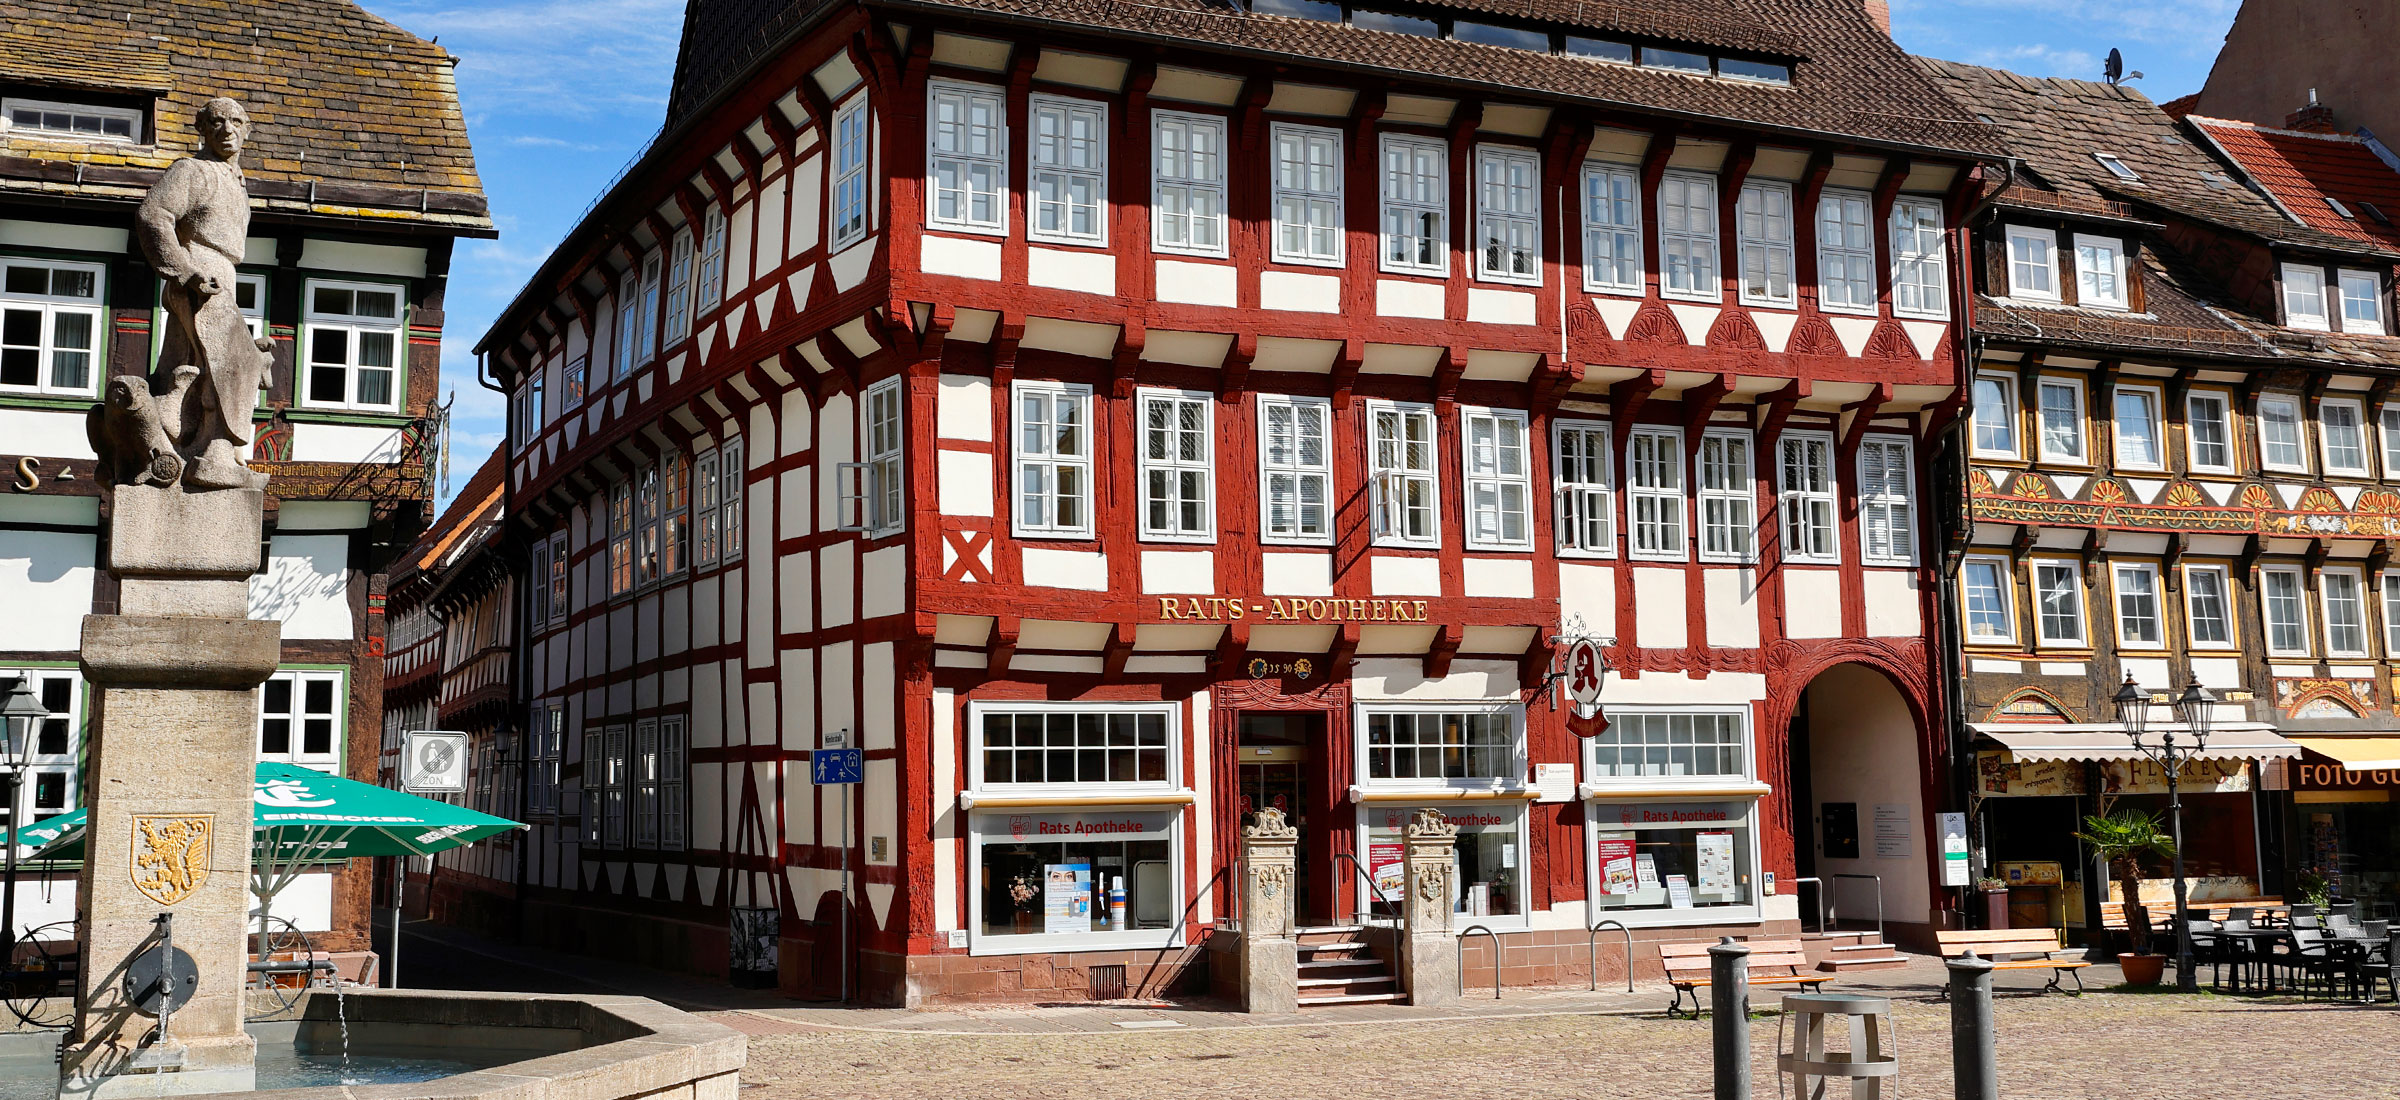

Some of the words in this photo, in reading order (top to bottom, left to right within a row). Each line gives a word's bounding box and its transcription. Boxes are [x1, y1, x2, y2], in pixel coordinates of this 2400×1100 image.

[422, 776, 445, 785] ZON
[2129, 758, 2228, 786] FLRES
[2299, 763, 2362, 786] FOTO
[1643, 810, 1669, 823] Rats
[1671, 808, 1727, 824] Apotheke
[1039, 821, 1071, 835] Rats
[1074, 819, 1143, 837] Apotheke
